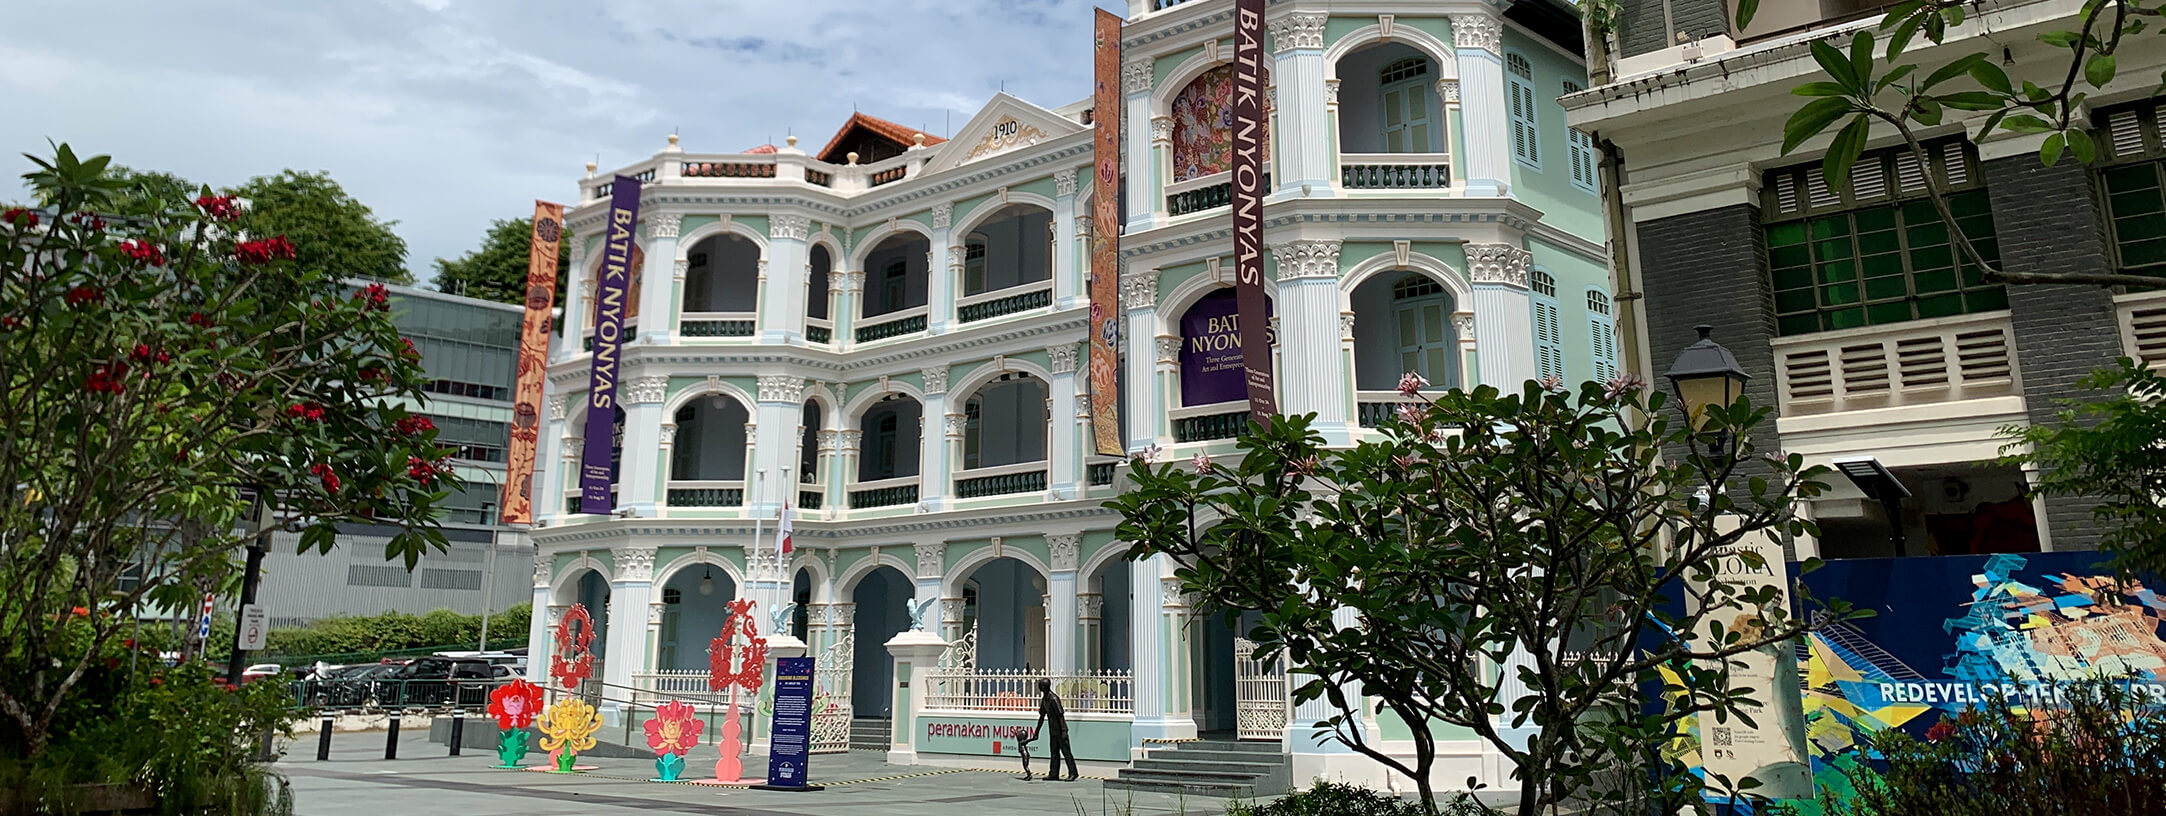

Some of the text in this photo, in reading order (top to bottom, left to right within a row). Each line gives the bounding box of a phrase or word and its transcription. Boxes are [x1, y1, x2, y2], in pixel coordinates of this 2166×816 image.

[994, 120, 1017, 139] 1910
[1236, 7, 1260, 286] BATIK NYONYAS
[606, 207, 633, 282] BATIK
[592, 286, 622, 409] NYONYAS
[1208, 313, 1240, 334] BAT
[927, 721, 990, 742] peranakan
